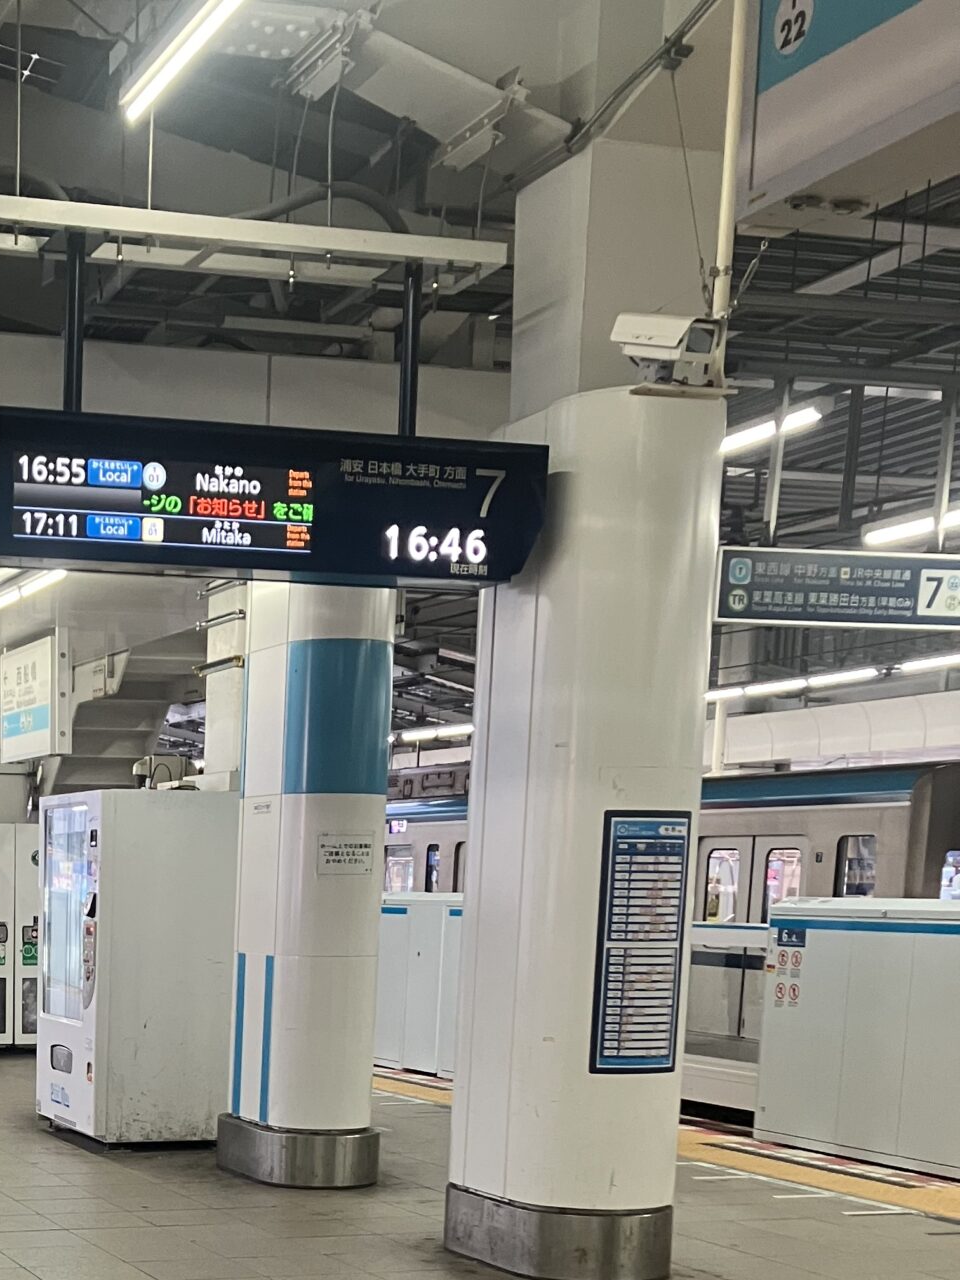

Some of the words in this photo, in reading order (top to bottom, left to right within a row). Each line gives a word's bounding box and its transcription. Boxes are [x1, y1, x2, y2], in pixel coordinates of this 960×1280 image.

[780, 10, 806, 50] 22
[19, 454, 86, 485] 16:55
[99, 467, 131, 483] Local
[148, 474, 160, 483] 01
[214, 465, 243, 477] なかの
[340, 458, 364, 473] 浦安
[368, 461, 402, 476] 日本橋
[406, 463, 440, 478] 大手町
[444, 466, 467, 480] 方面
[195, 473, 261, 495] Nakano
[475, 468, 507, 518] 7
[22, 511, 78, 537] 17:11
[100, 522, 128, 535] Local
[202, 527, 252, 546] Mitaka
[385, 524, 487, 564] 16:46
[450, 563, 488, 576] 現在時刻
[731, 594, 745, 605] TR
[926, 577, 944, 608] 7
[781, 929, 789, 942] 6
